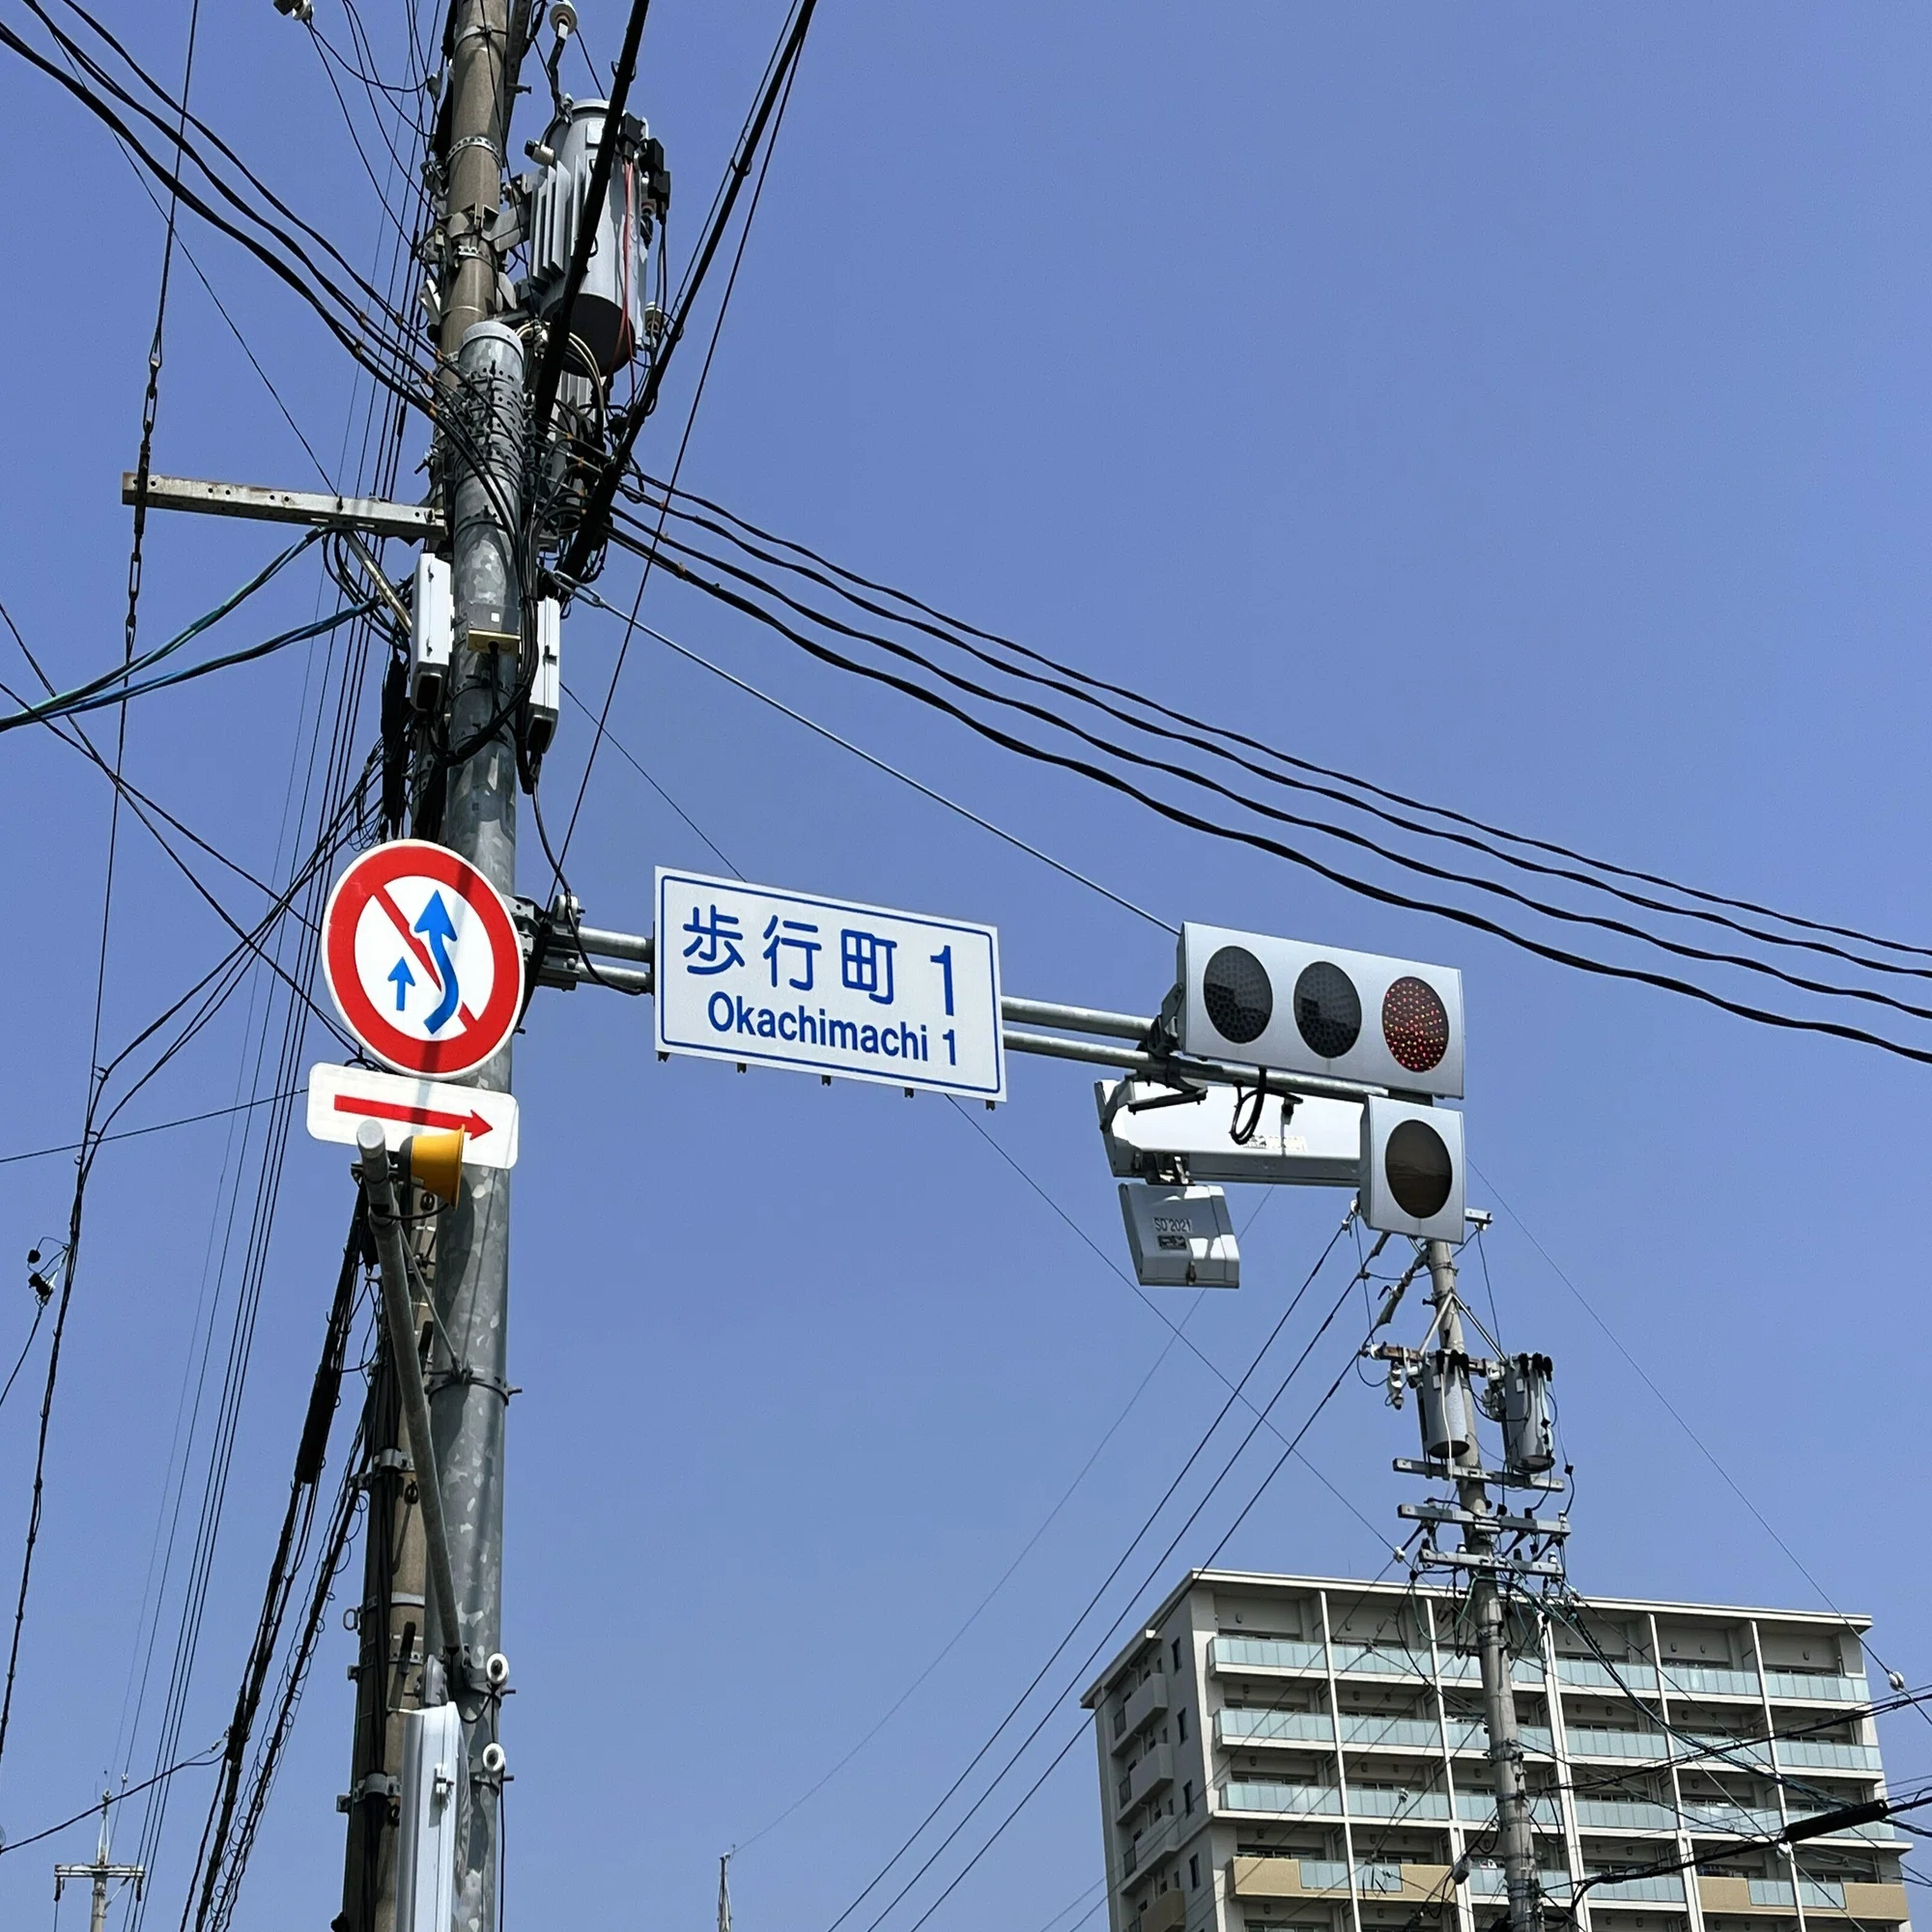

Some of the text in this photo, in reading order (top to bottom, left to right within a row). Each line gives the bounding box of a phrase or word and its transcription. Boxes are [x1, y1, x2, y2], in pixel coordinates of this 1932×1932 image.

[682, 904, 954, 1016] 歩行町 1
[707, 991, 956, 1066] Okachimachi 1
